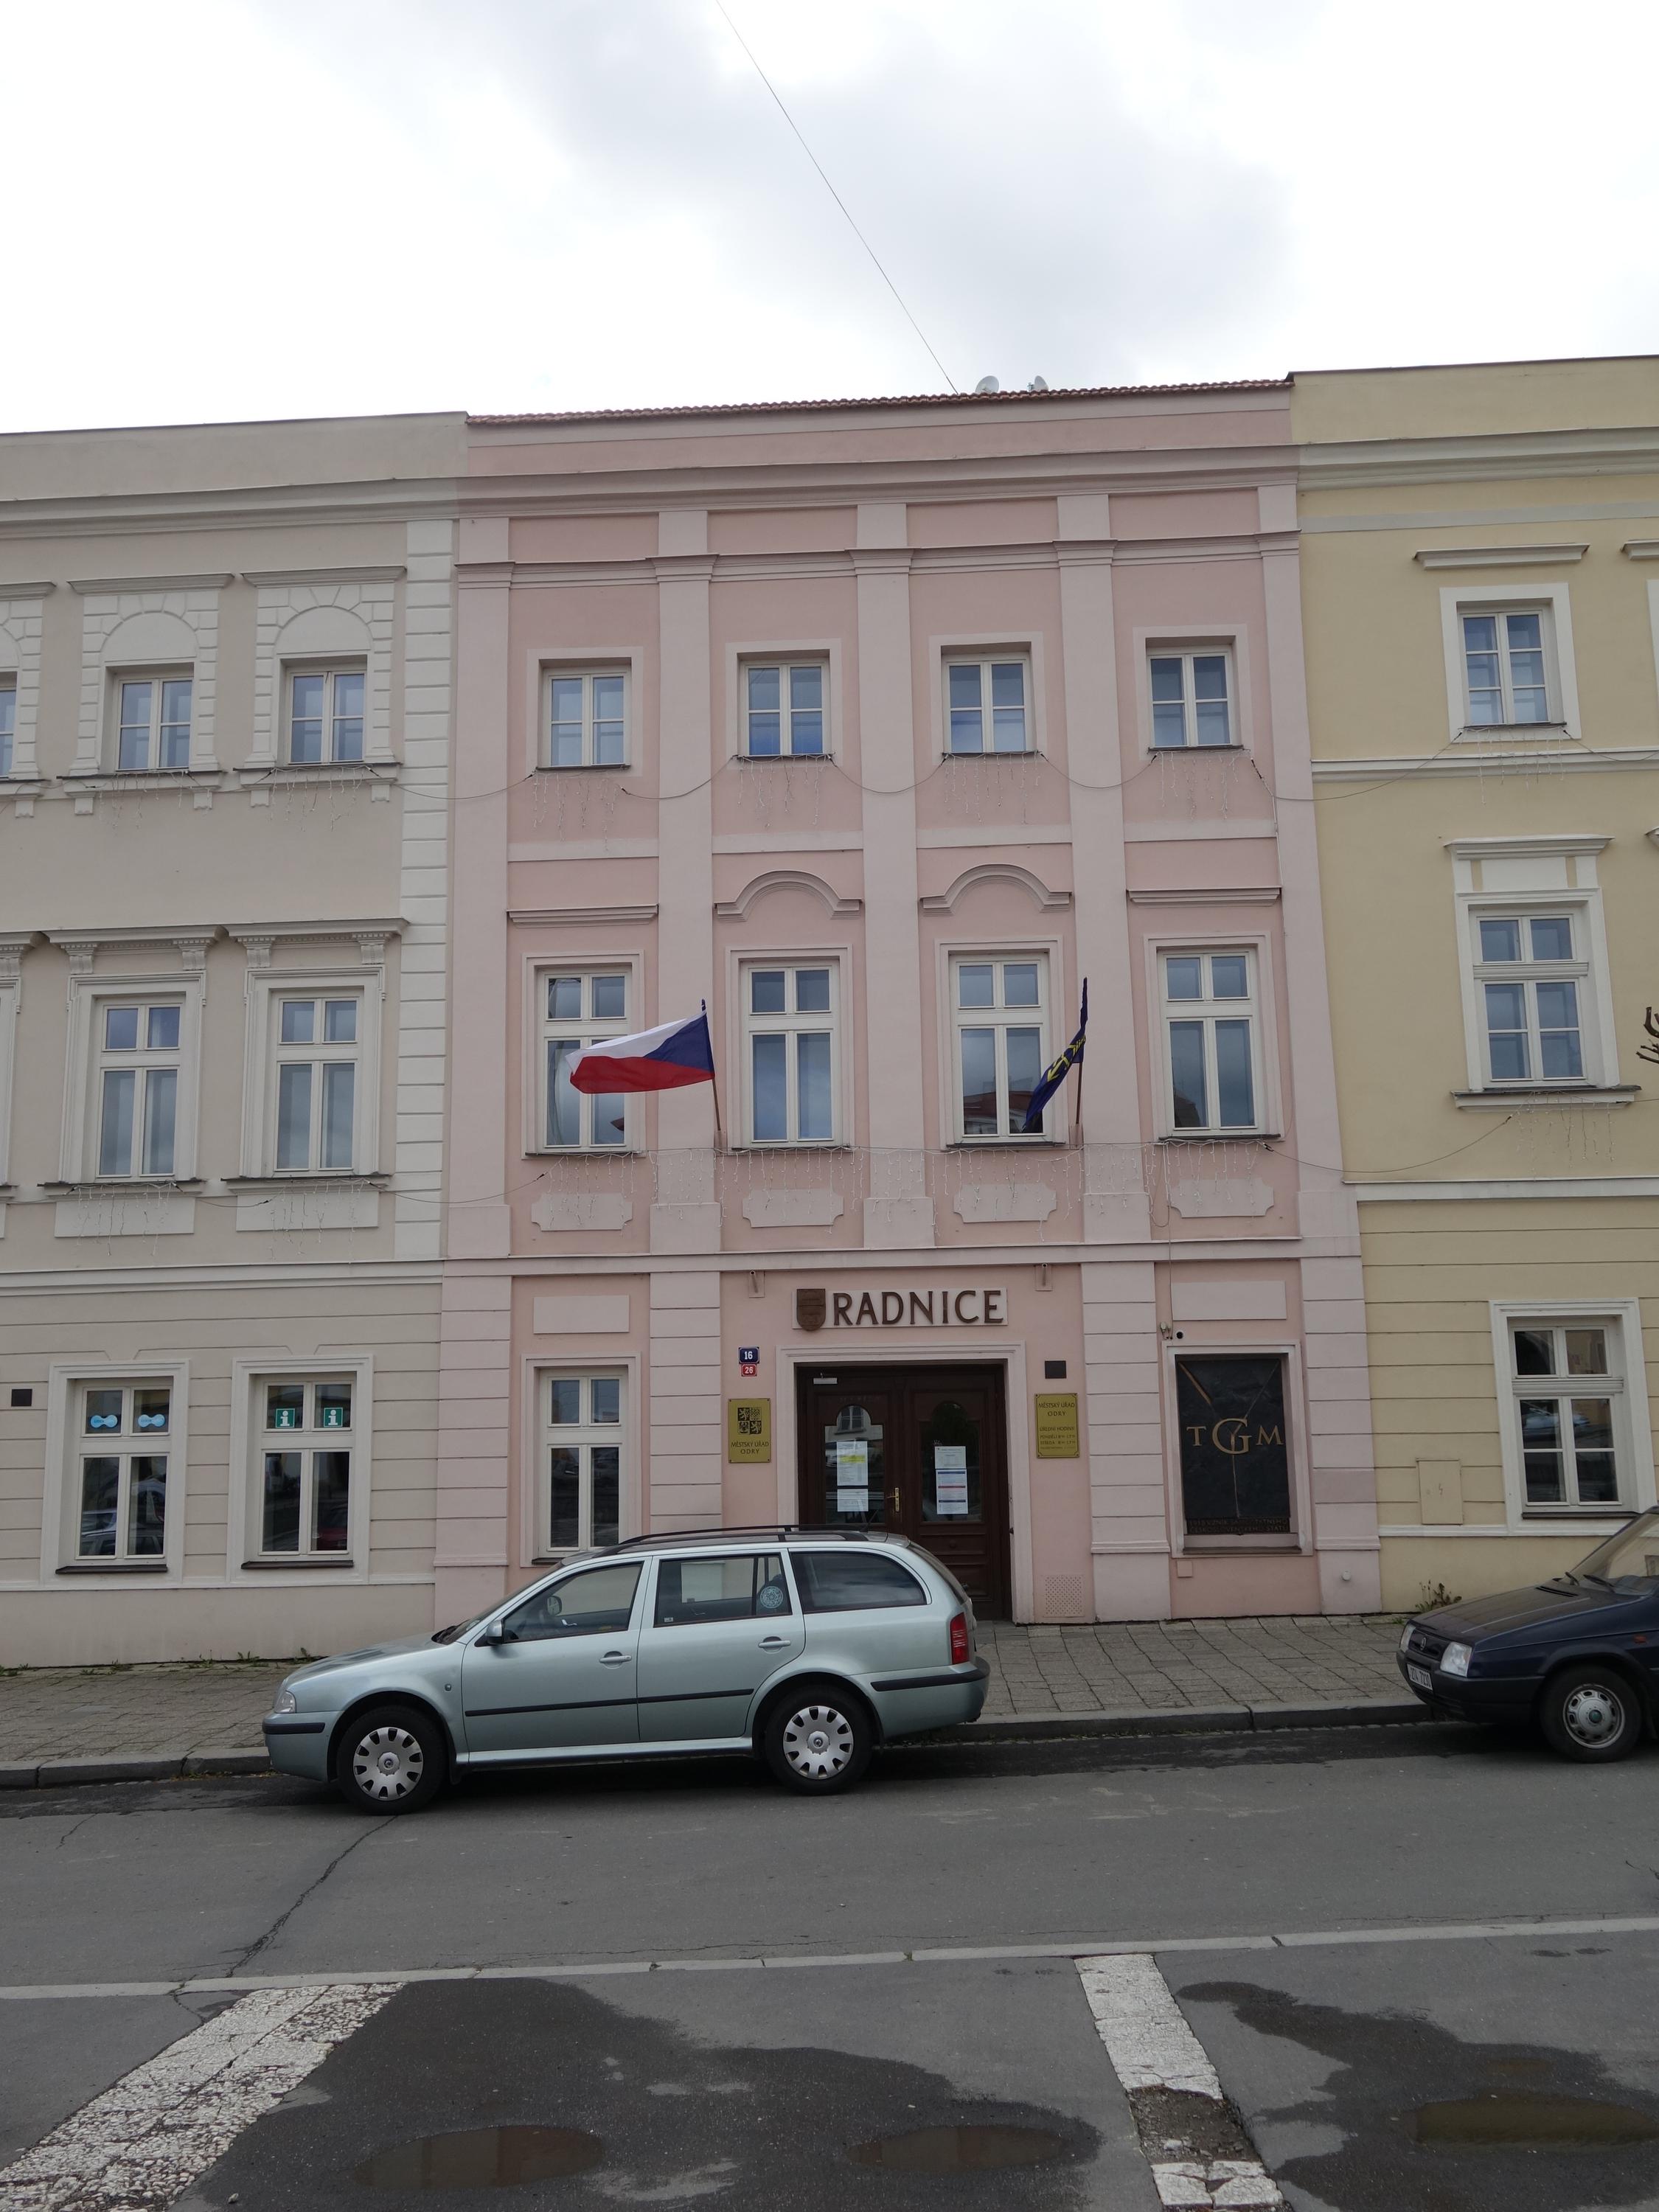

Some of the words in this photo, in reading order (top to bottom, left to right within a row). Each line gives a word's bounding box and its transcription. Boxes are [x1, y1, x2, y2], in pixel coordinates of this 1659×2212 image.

[833, 1290, 1004, 1326] RADNICE
[744, 1351, 753, 1360] 16
[731, 1440, 754, 1448] MĚSTSKÝ
